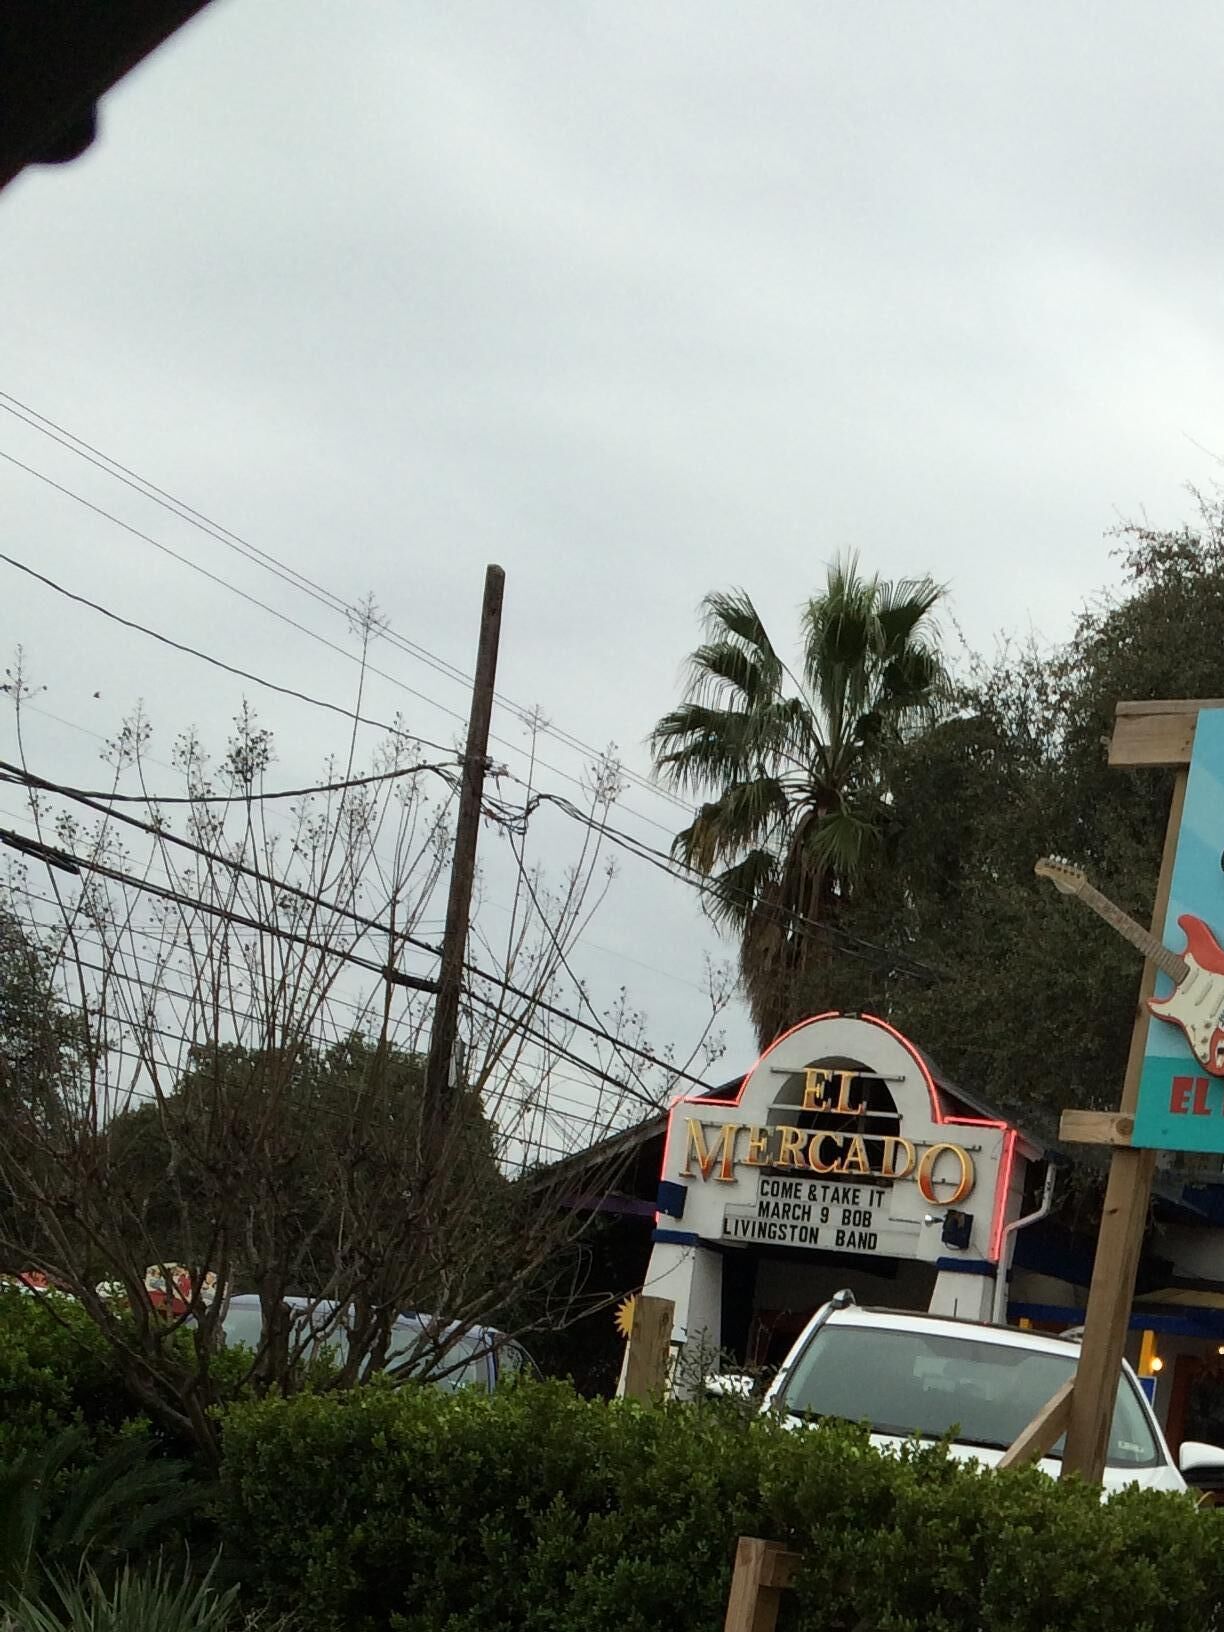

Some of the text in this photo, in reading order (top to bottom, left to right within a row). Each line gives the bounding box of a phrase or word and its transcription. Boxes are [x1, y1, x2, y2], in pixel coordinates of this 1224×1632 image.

[802, 1066, 868, 1116] EL
[1169, 1075, 1211, 1116] EL
[679, 1117, 977, 1205] MERCADO
[760, 1179, 803, 1200] COME
[869, 1189, 886, 1208] IT
[757, 1200, 873, 1228] MARCH 9 BOB
[723, 1217, 878, 1250] LIVINGSTON BAND
